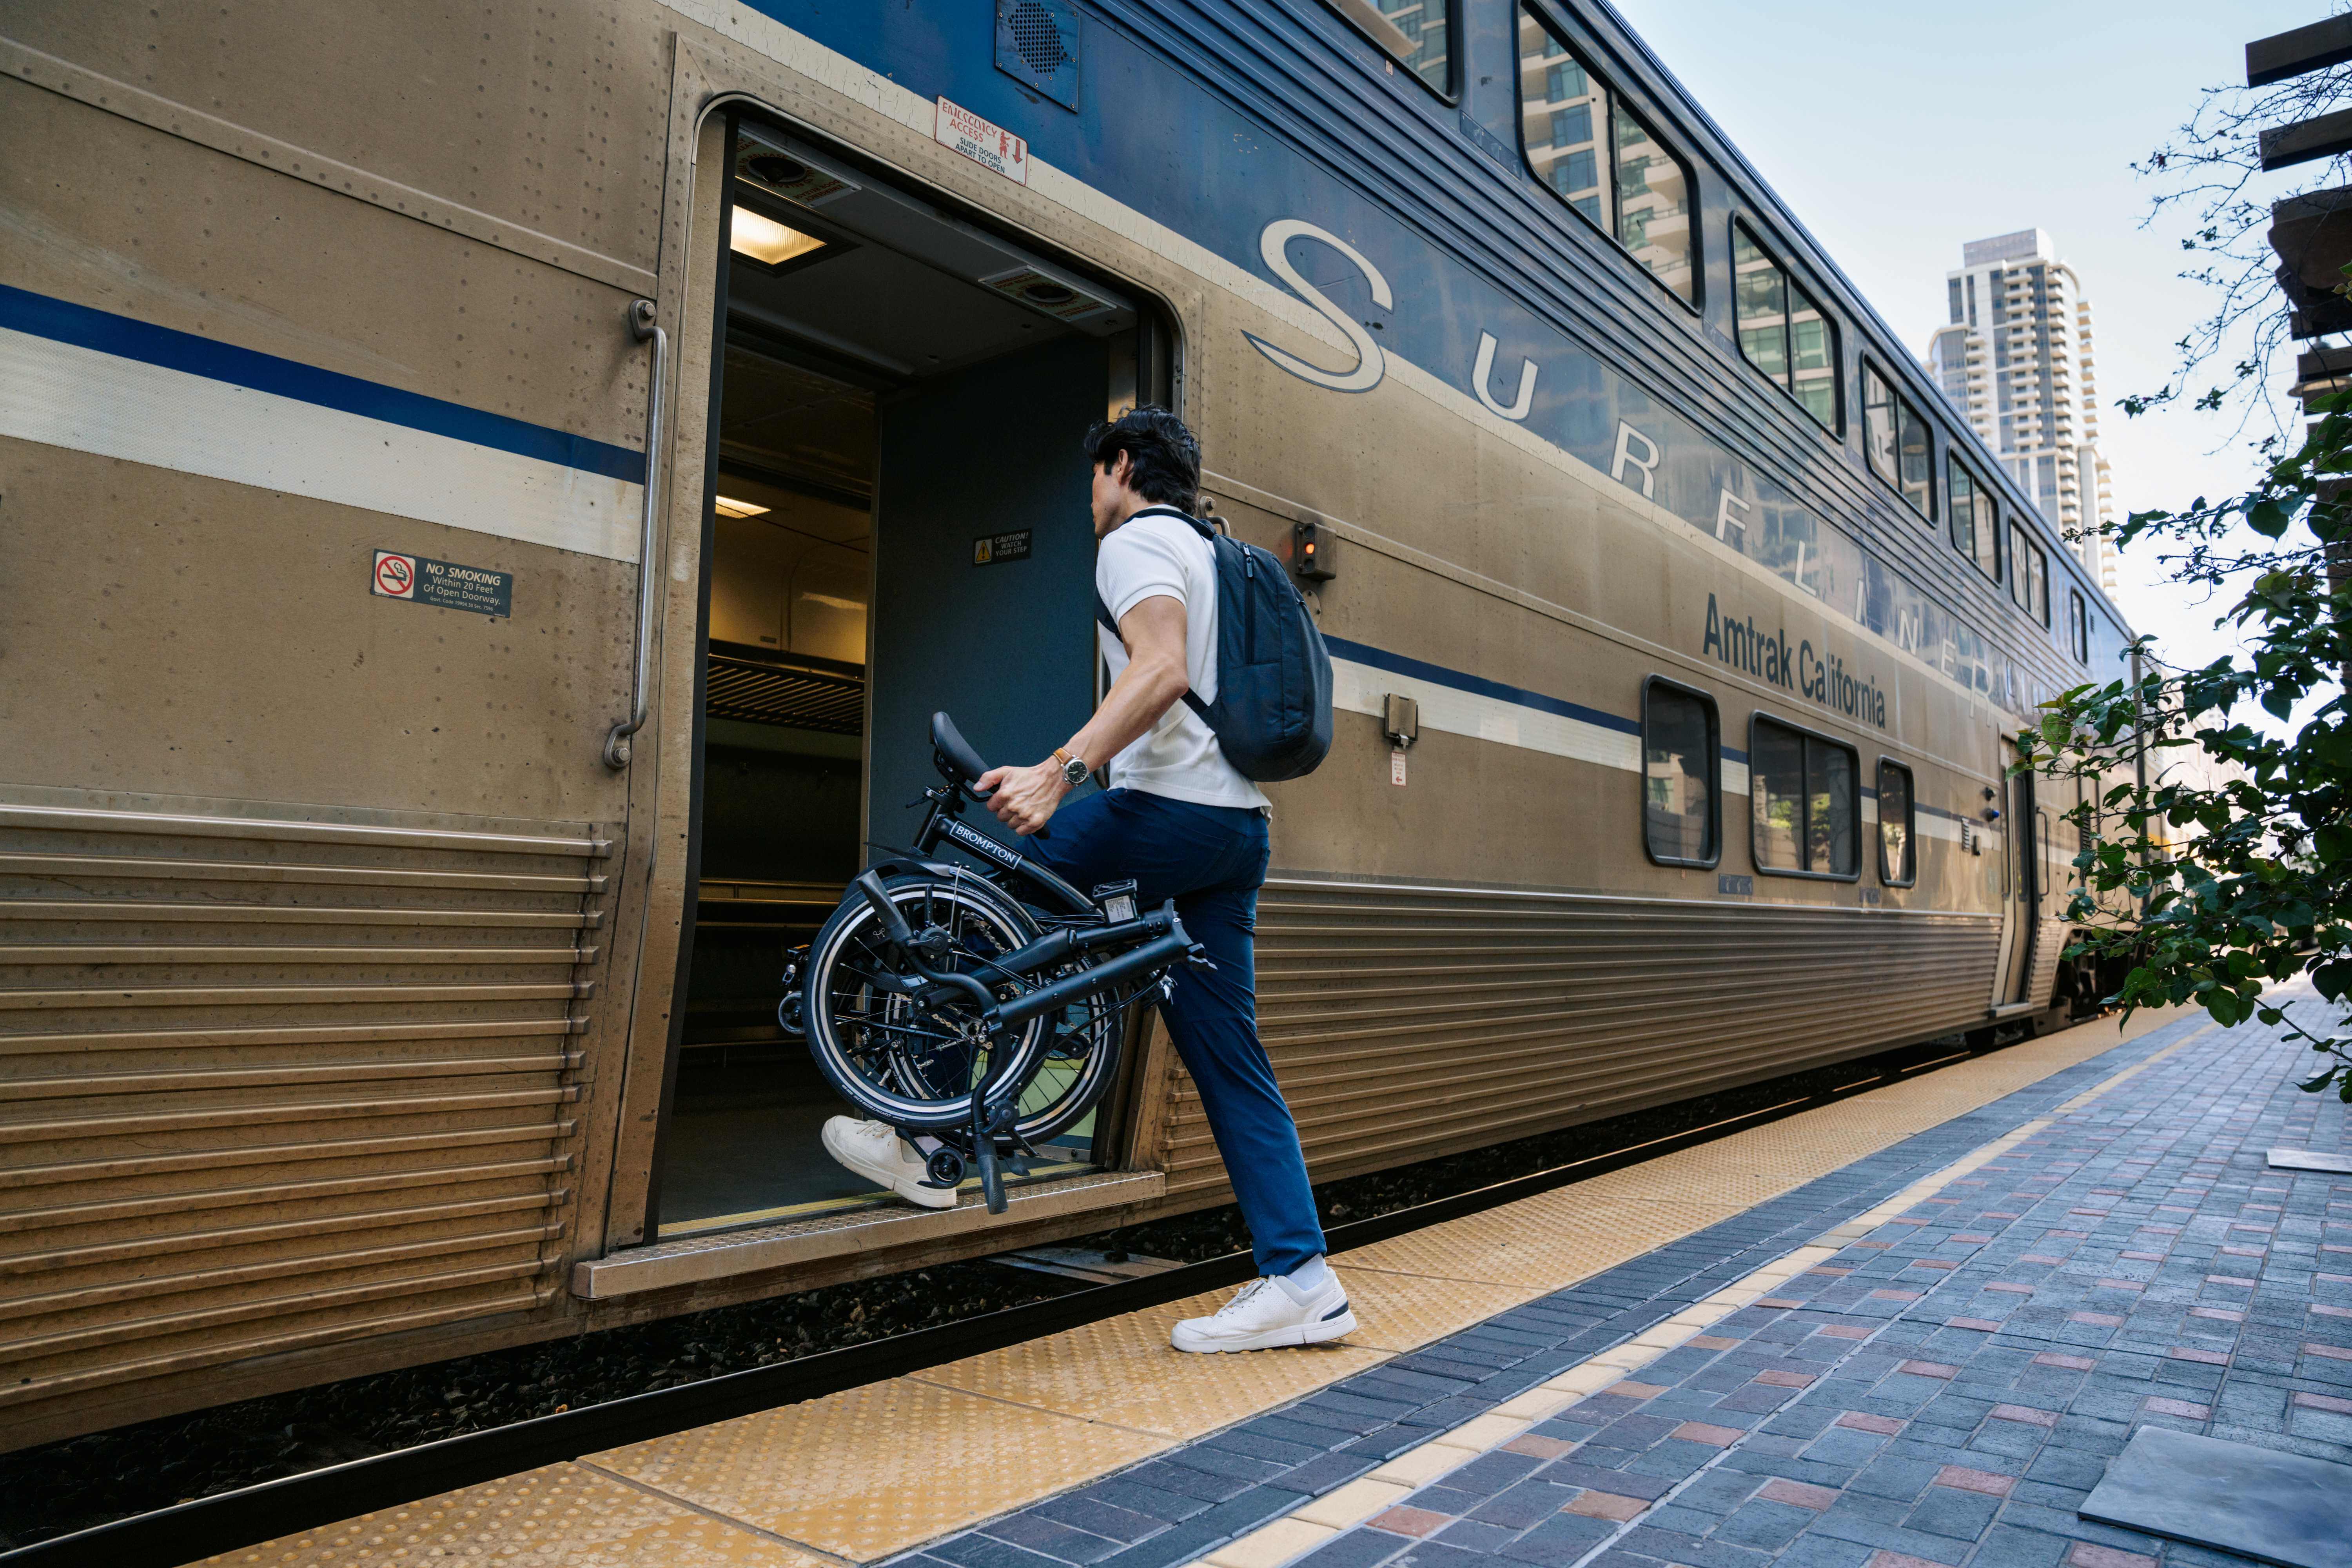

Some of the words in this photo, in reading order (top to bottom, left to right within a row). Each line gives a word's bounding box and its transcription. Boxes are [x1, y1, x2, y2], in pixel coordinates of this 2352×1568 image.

[950, 119, 984, 143] ACCESS
[955, 143, 975, 158] APART
[978, 153, 987, 164] TO
[988, 160, 1005, 174] OPEN
[960, 137, 977, 151] SLIDE
[979, 147, 1001, 164] DOORS
[1242, 218, 1993, 728] SURFLINER
[995, 532, 1028, 544] CAUTION!
[1001, 540, 1022, 549] WATCH
[996, 548, 1011, 557] YOUR
[426, 563, 444, 575] NO
[448, 568, 501, 586] SMOKING
[433, 576, 461, 588] Within
[464, 581, 474, 590] 20
[476, 584, 494, 594] Feet
[424, 584, 435, 593] Of
[437, 586, 459, 597] Open
[462, 591, 500, 606] Doorway.
[1702, 592, 1794, 691] Amtrak
[1799, 639, 1886, 729] California
[955, 825, 1016, 863] BROMPTON
[964, 887, 995, 904] CONTINENTAL
